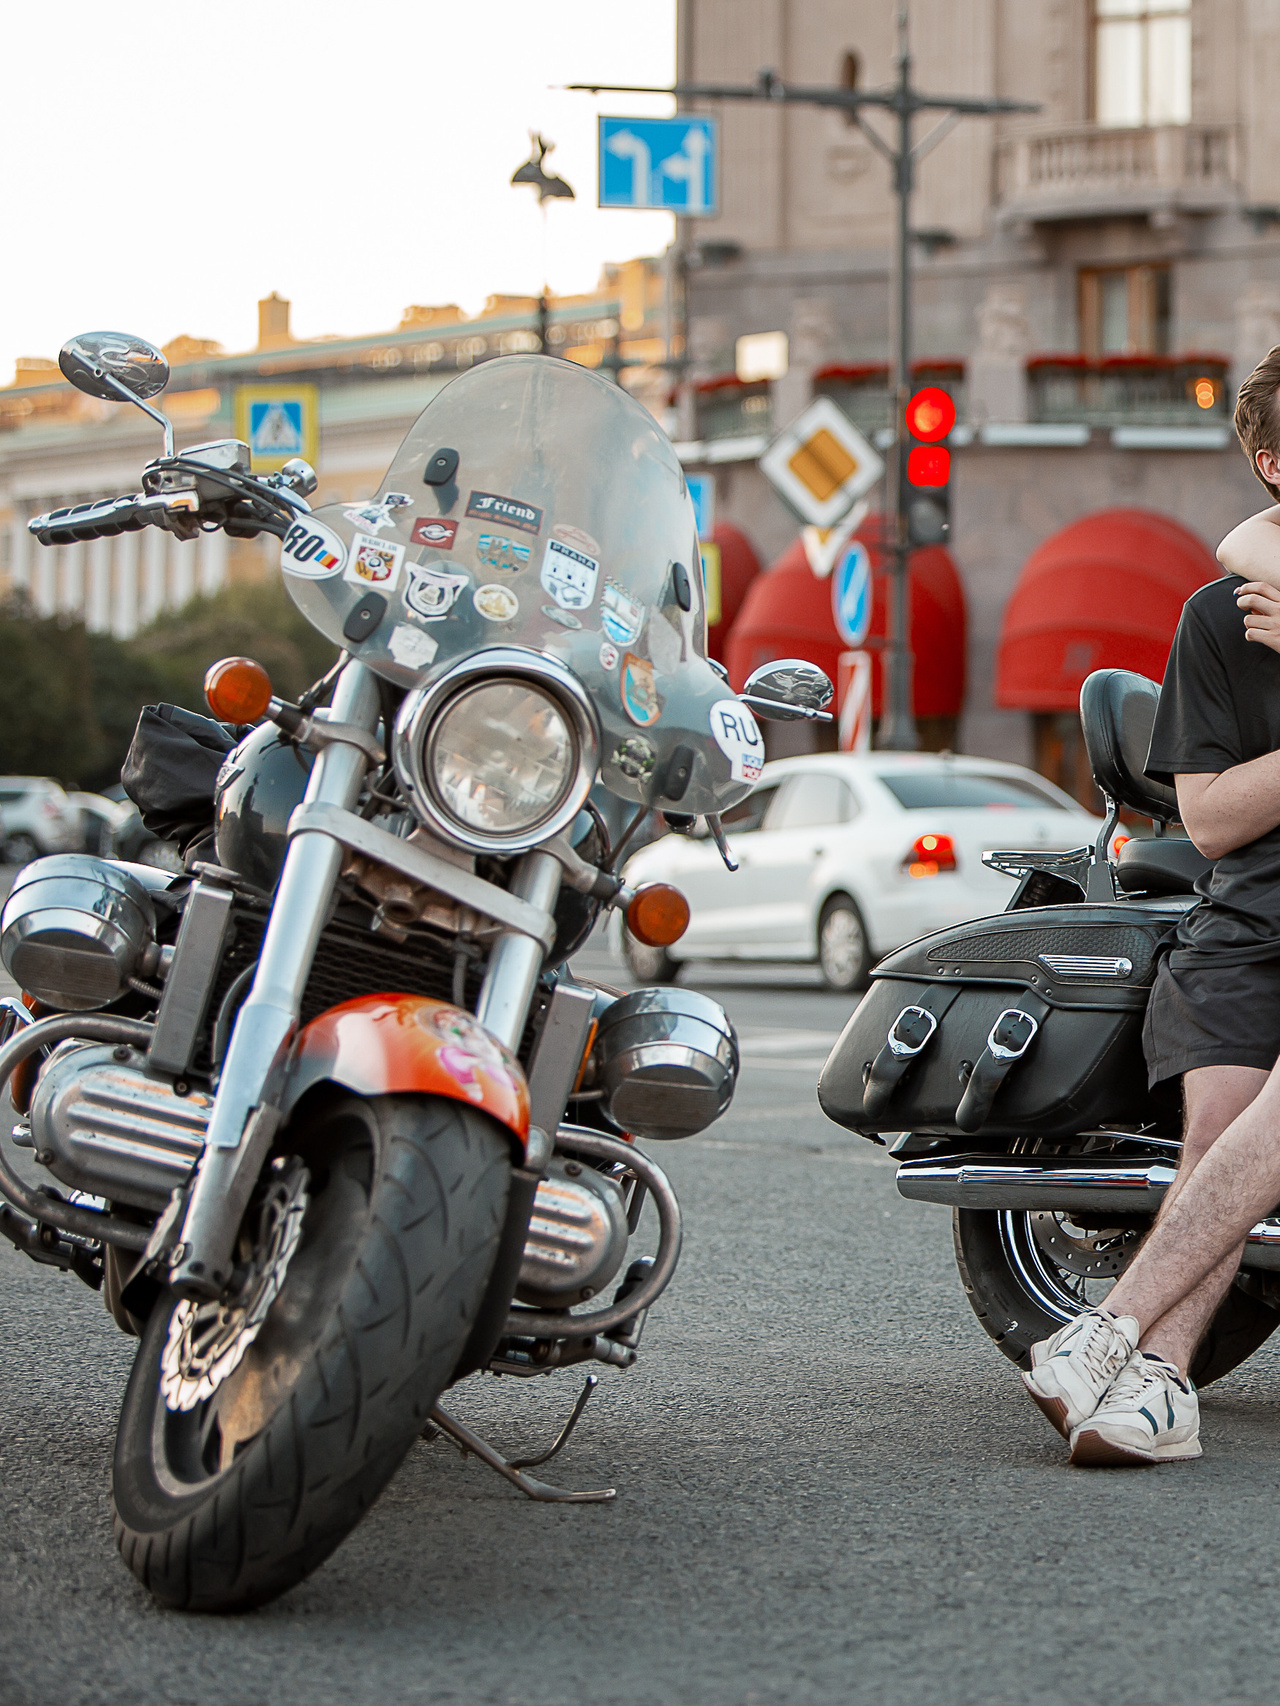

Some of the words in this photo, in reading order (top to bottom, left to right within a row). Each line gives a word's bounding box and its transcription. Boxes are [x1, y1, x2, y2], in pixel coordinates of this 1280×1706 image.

[475, 496, 536, 520] Friend
[284, 524, 324, 562] RO
[551, 542, 595, 570] PRAHA
[720, 711, 758, 746] RU
